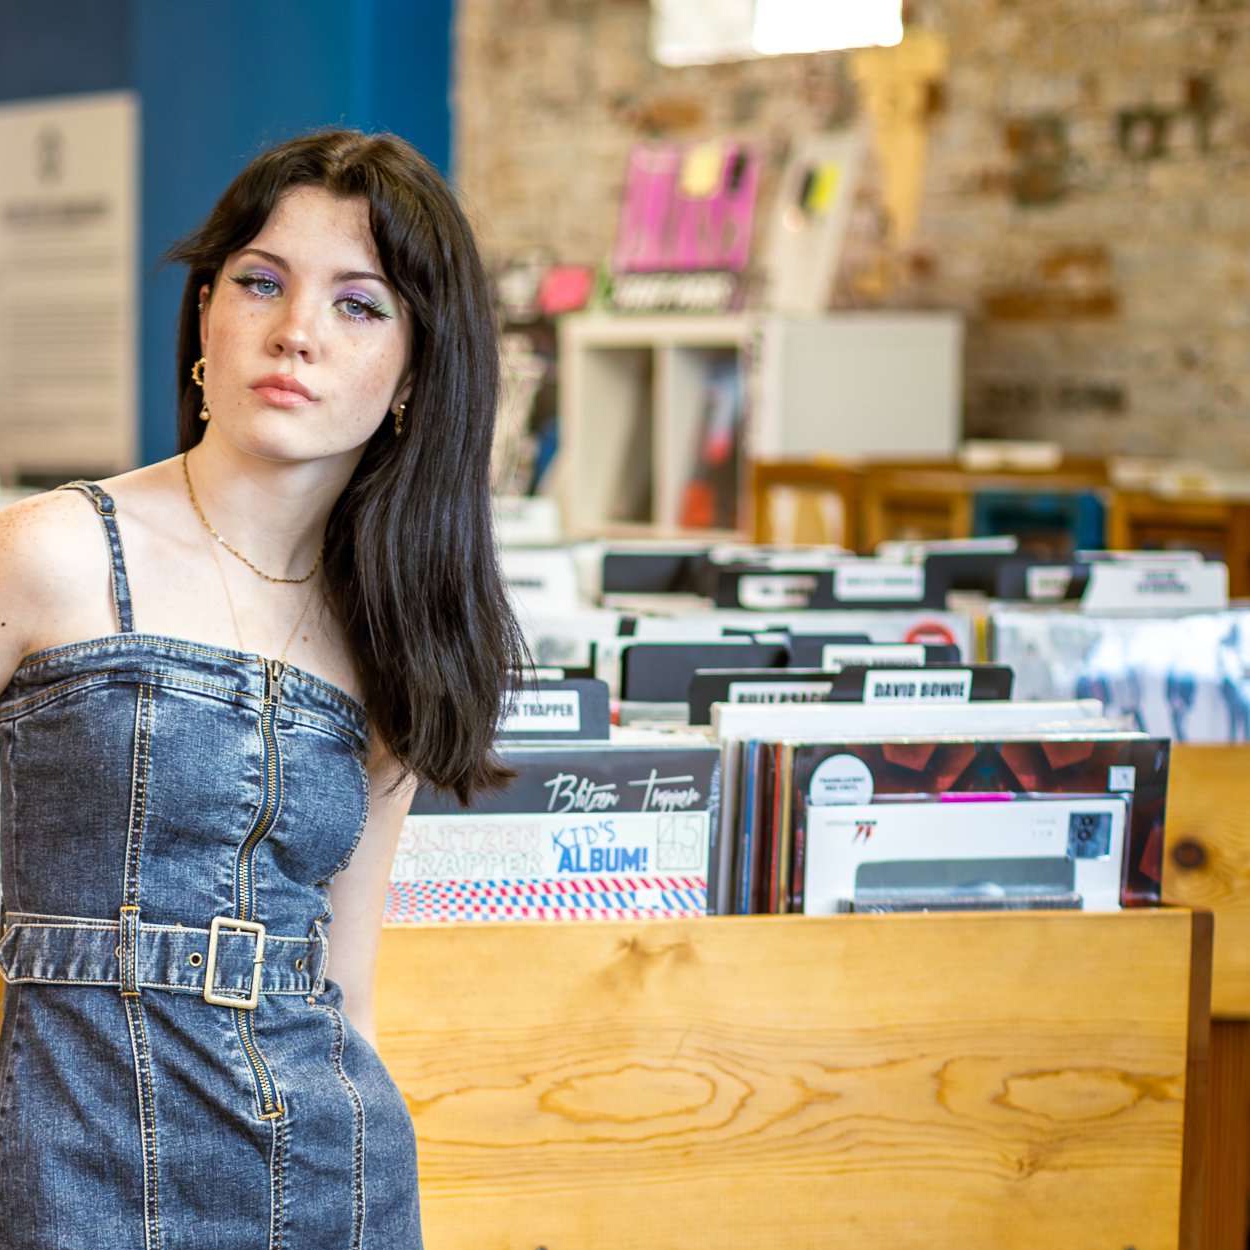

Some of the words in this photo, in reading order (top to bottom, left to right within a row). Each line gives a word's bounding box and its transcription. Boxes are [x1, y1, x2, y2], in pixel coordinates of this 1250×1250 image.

[875, 682, 916, 697] DAVID
[921, 681, 964, 697] BOWIE
[523, 703, 574, 716] TRAPPER
[544, 773, 620, 813] Blitzen
[628, 768, 702, 813] Trapper
[551, 820, 615, 851] KID'S
[558, 847, 648, 872] ALBUM!
